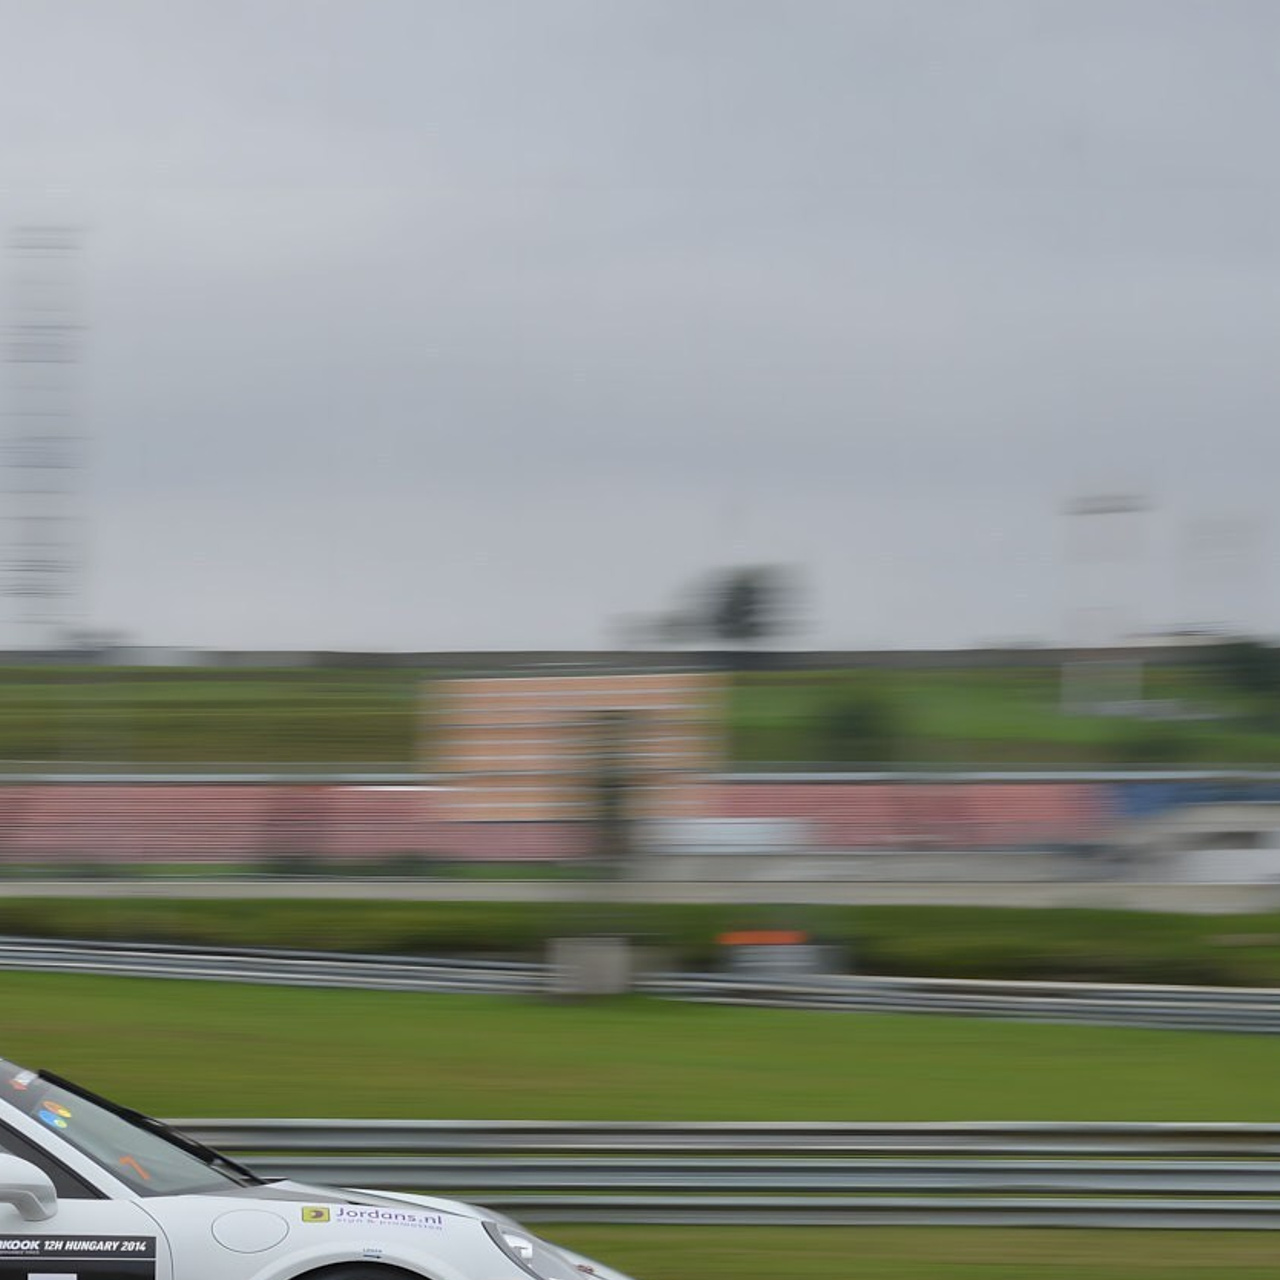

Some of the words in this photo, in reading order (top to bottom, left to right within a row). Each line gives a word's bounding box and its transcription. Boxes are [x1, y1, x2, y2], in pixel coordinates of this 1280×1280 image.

[336, 1207, 443, 1225] Jordans.nl
[43, 1240, 62, 1250] 12H
[65, 1240, 118, 1251] HUNGARY
[120, 1241, 147, 1252] 2014
